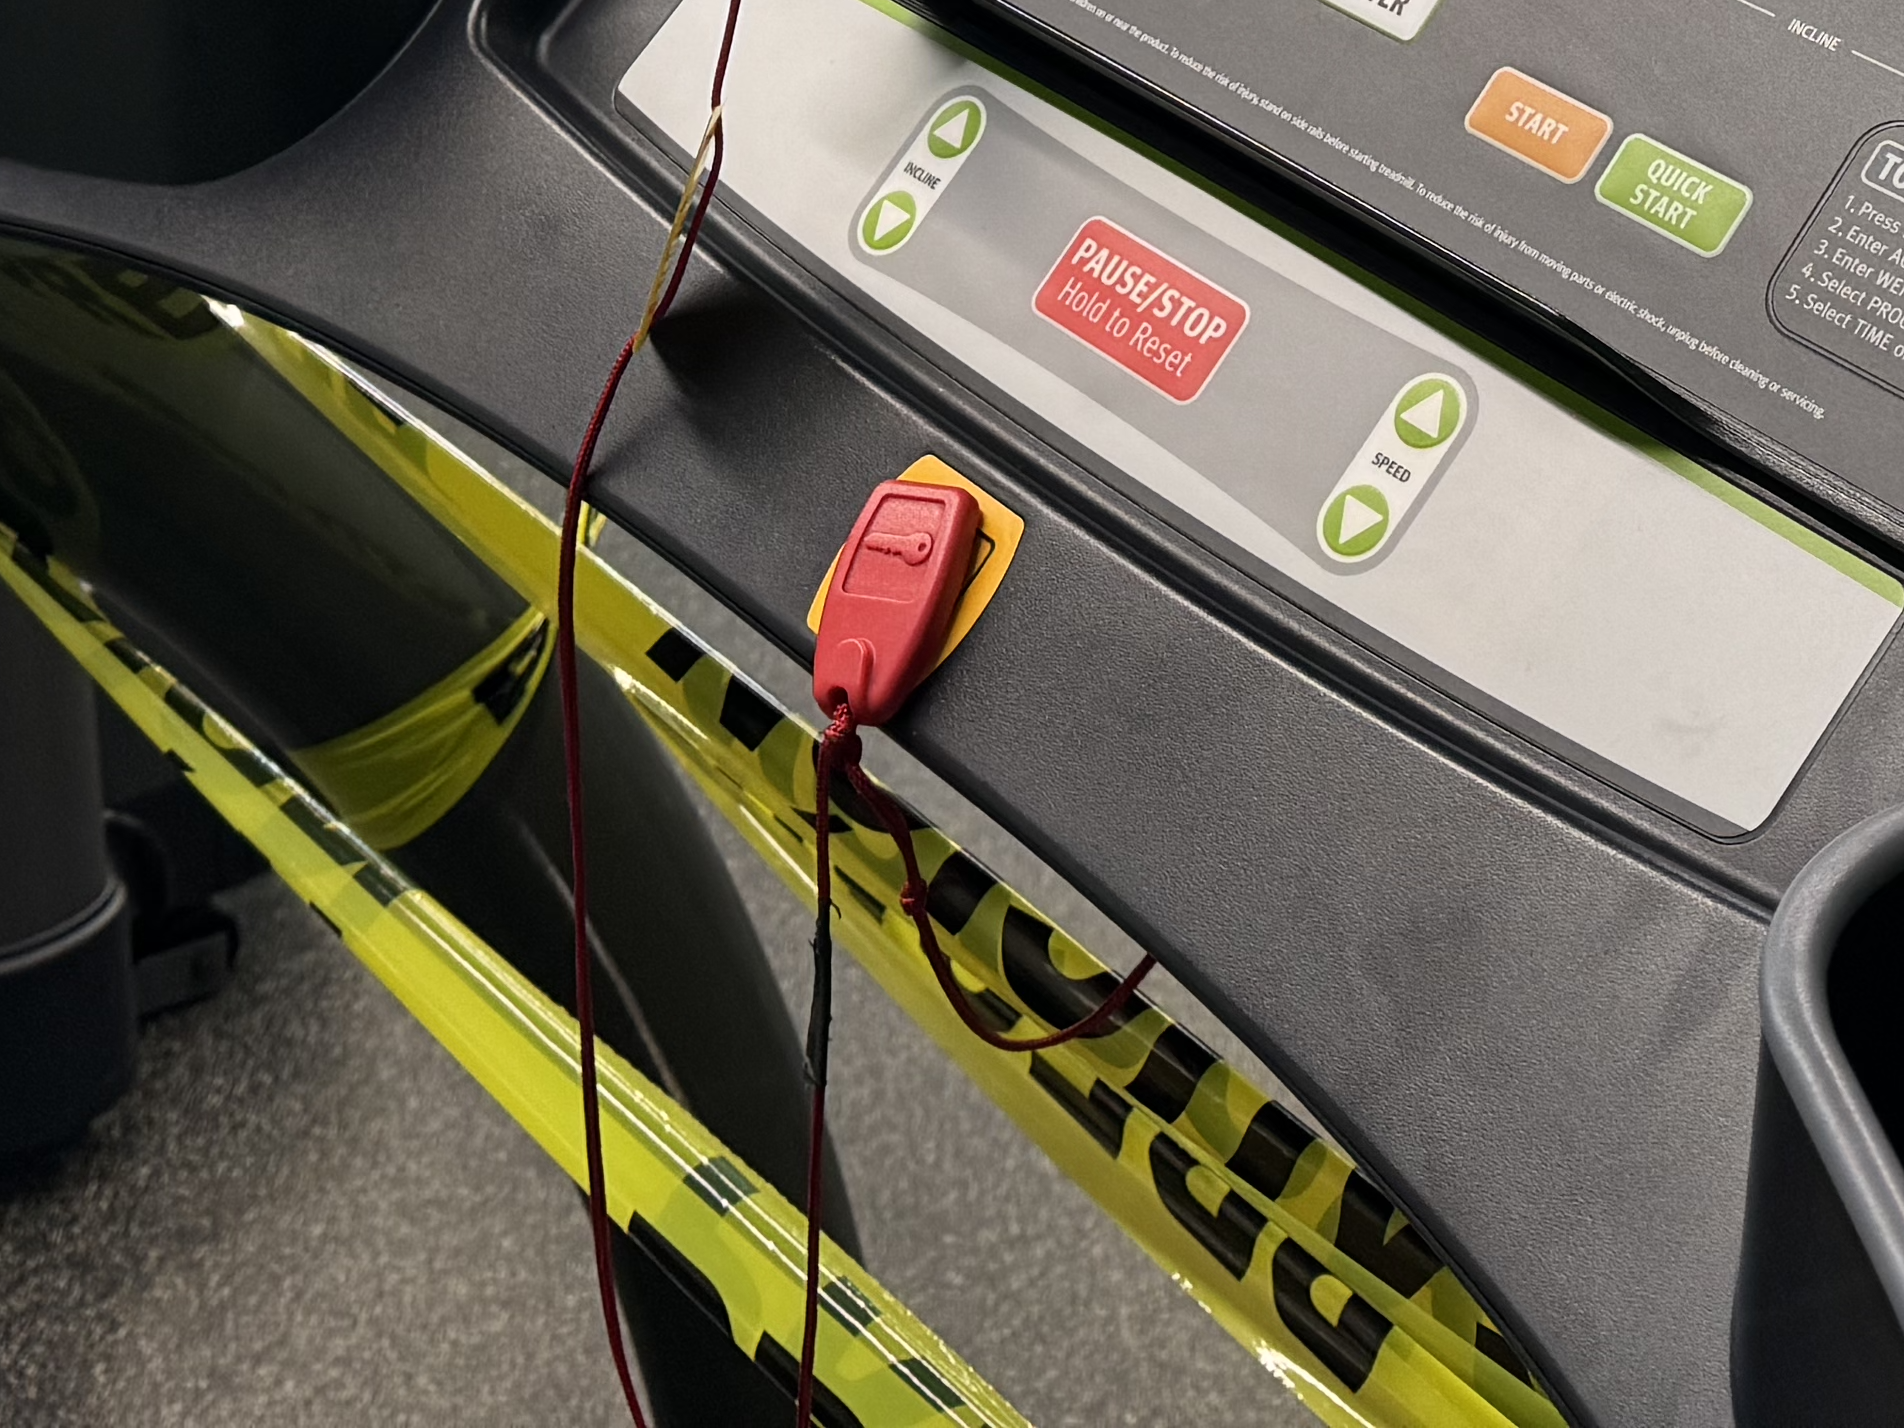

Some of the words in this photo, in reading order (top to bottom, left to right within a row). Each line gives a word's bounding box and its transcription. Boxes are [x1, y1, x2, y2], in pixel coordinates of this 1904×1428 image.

[1787, 18, 1841, 51] INCLINE
[1504, 101, 1569, 144] START
[903, 161, 941, 190] INCLINE
[1647, 158, 1713, 204] QUICK
[1094, 8, 1106, 18] on
[1104, 13, 1114, 22] or
[1112, 17, 1130, 31] near
[1128, 25, 1142, 38] the
[1139, 33, 1169, 54] product.
[1169, 46, 1179, 58] To
[1177, 53, 1203, 72] reduce
[1201, 65, 1216, 79] the
[1214, 73, 1230, 87] risk
[1228, 81, 1240, 91] of
[1236, 83, 1259, 105] injury,
[1258, 98, 1283, 116] stand
[1280, 110, 1292, 121] on
[1290, 115, 1308, 131] side
[1306, 125, 1325, 139] rails
[1347, 148, 1379, 172] starting
[1415, 182, 1426, 196] To
[1424, 190, 1454, 211] reduce
[1453, 205, 1468, 220] the
[1467, 213, 1485, 228] risk
[1483, 223, 1496, 234] of
[1493, 225, 1519, 248] injury
[1517, 240, 1539, 259] from
[1538, 253, 1572, 279] moving
[1568, 271, 1595, 289] parts
[1593, 284, 1606, 295] or
[1604, 290, 1638, 314] electric
[1636, 308, 1666, 332] shock,
[1666, 324, 1699, 350] unplug
[1728, 359, 1770, 389] cleaning
[1768, 381, 1781, 393] or
[1779, 388, 1824, 420] servicing.
[1629, 183, 1697, 229] START
[1844, 194, 1855, 213] 1.
[1857, 201, 1901, 234] Press
[1827, 216, 1842, 237] 2.
[1845, 225, 1889, 256] Enter
[1813, 239, 1828, 259] 3.
[1831, 247, 1874, 278] Enter
[1071, 237, 1227, 344] PAUSE/STOP
[1801, 262, 1815, 282] 4.
[1816, 271, 1866, 306] Select
[1056, 276, 1111, 323] Hold
[1104, 307, 1130, 338] to
[1128, 321, 1192, 377] Reset
[1784, 284, 1801, 304] 5.
[1802, 293, 1852, 329] Select
[1853, 318, 1894, 351] TIME
[1371, 452, 1411, 483] SPEED
